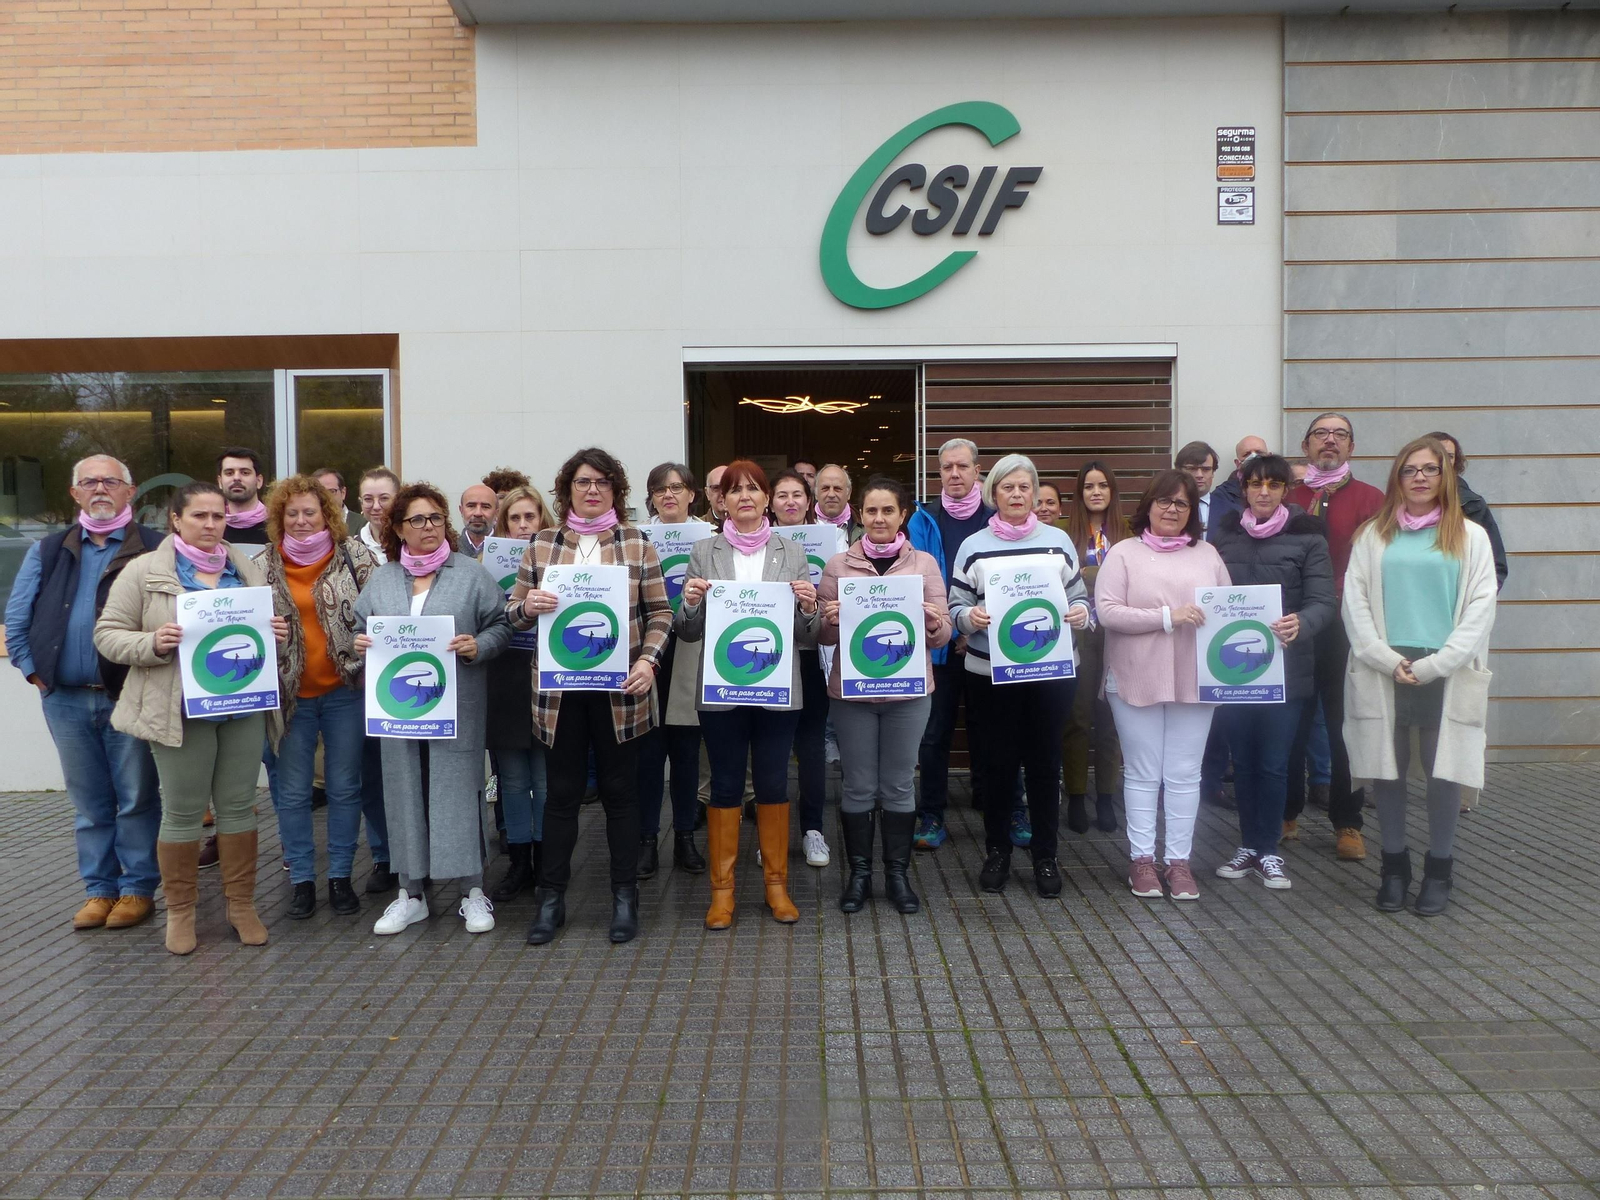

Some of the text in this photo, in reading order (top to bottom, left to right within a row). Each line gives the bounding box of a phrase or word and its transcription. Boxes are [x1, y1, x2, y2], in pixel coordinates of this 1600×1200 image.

[866, 163, 1044, 236] CSIF
[572, 573, 593, 583] 8M
[1014, 573, 1031, 584] 8M
[573, 585, 611, 593] Internacional
[869, 584, 888, 595] 8M
[1015, 583, 1049, 592] Internacional
[739, 589, 758, 600] 8M
[213, 597, 234, 608] 8M
[739, 600, 776, 608] Internacional
[214, 608, 254, 617] Internacional
[398, 624, 417, 636] 8M
[223, 698, 240, 706] paso
